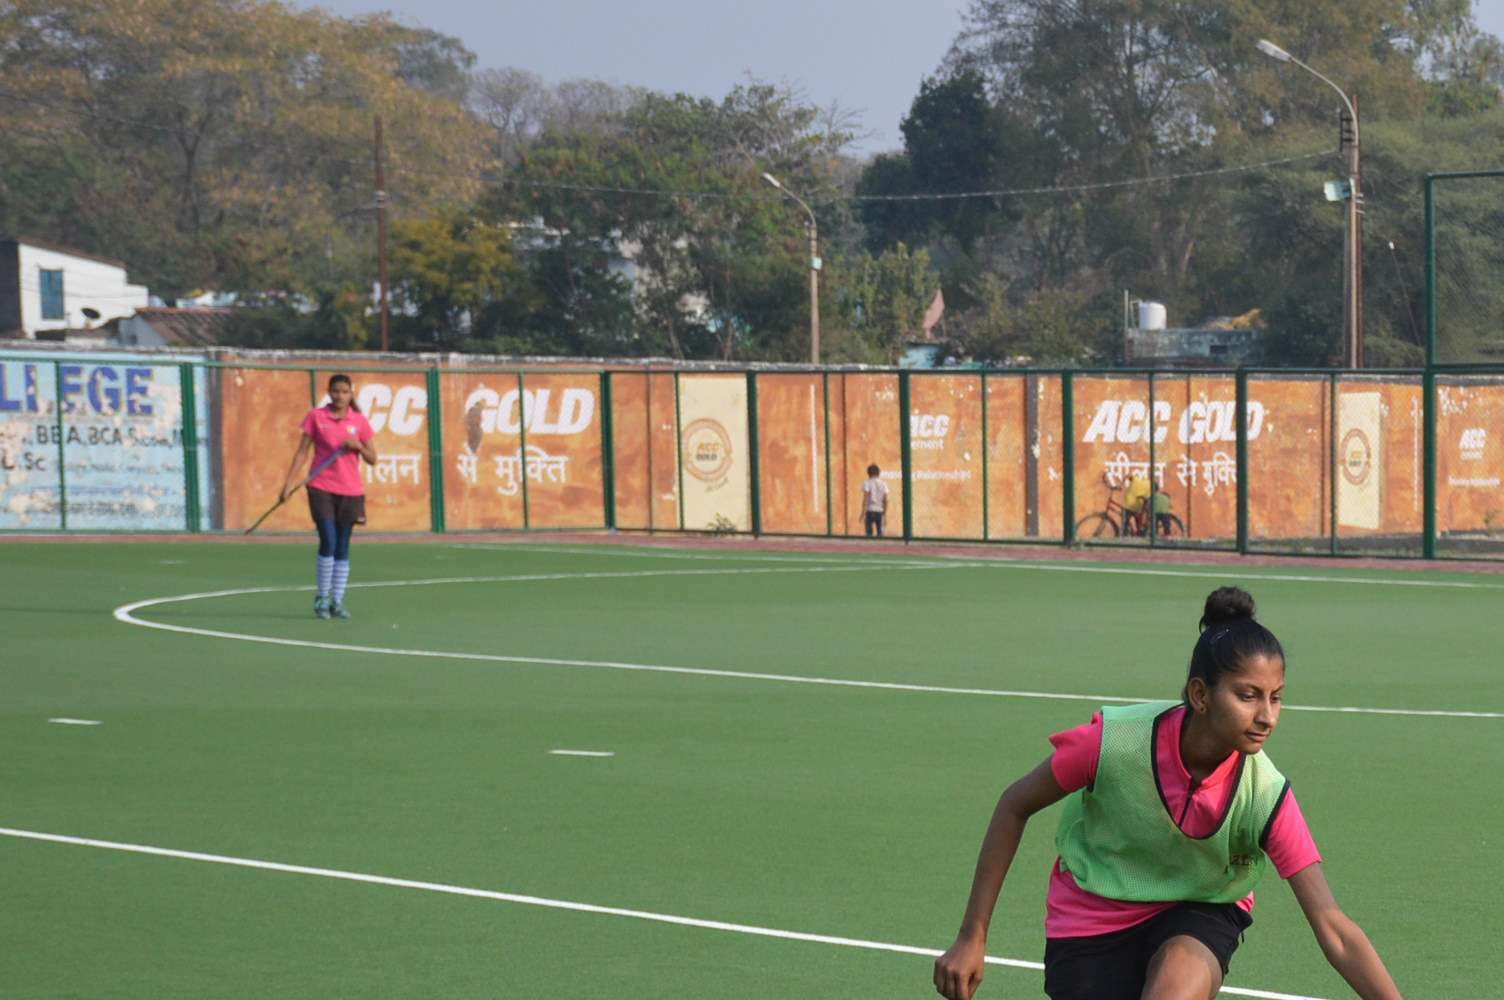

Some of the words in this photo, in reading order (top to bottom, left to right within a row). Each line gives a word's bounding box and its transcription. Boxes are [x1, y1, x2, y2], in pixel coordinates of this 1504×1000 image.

[465, 386, 595, 434] GOLD
[1082, 400, 1172, 443] ACC
[1178, 399, 1264, 443] GOLD
